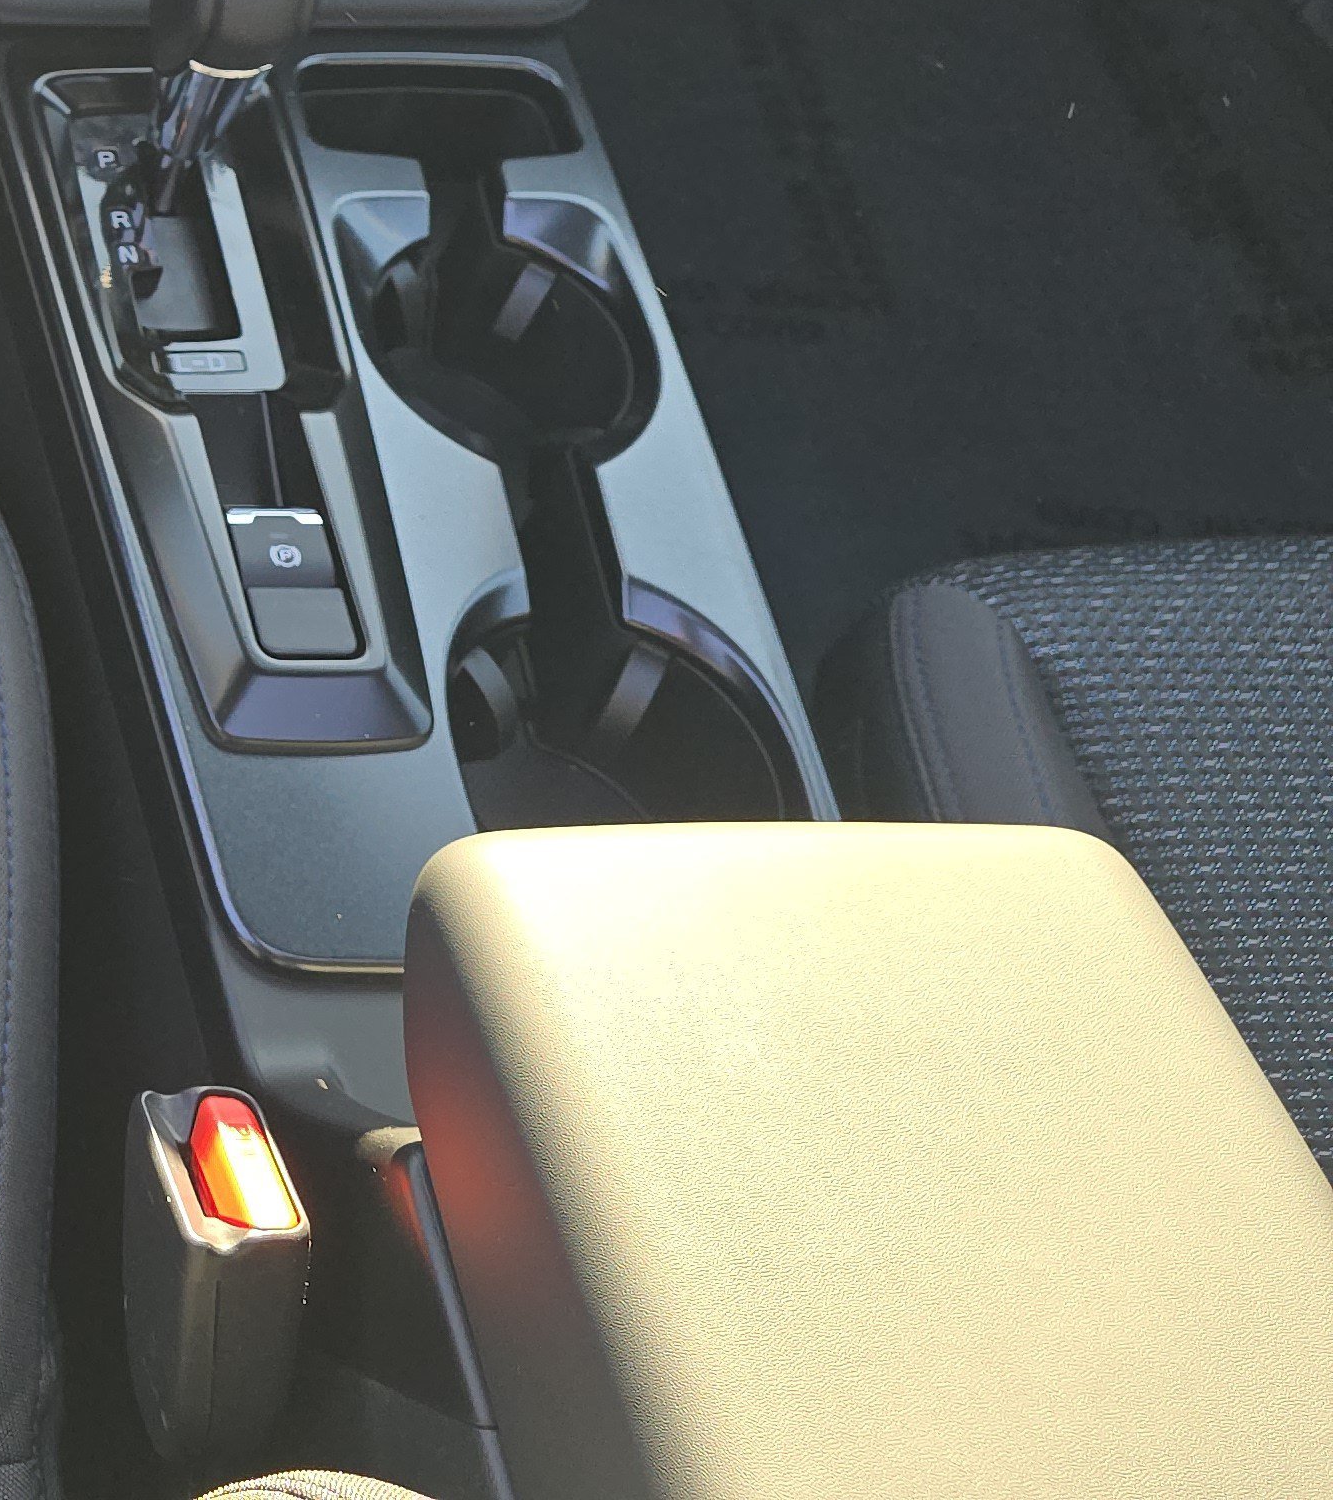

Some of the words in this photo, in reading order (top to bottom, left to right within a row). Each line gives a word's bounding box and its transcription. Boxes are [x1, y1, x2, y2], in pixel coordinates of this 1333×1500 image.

[97, 150, 117, 168] P
[110, 211, 131, 229] R
[118, 245, 140, 265] N
